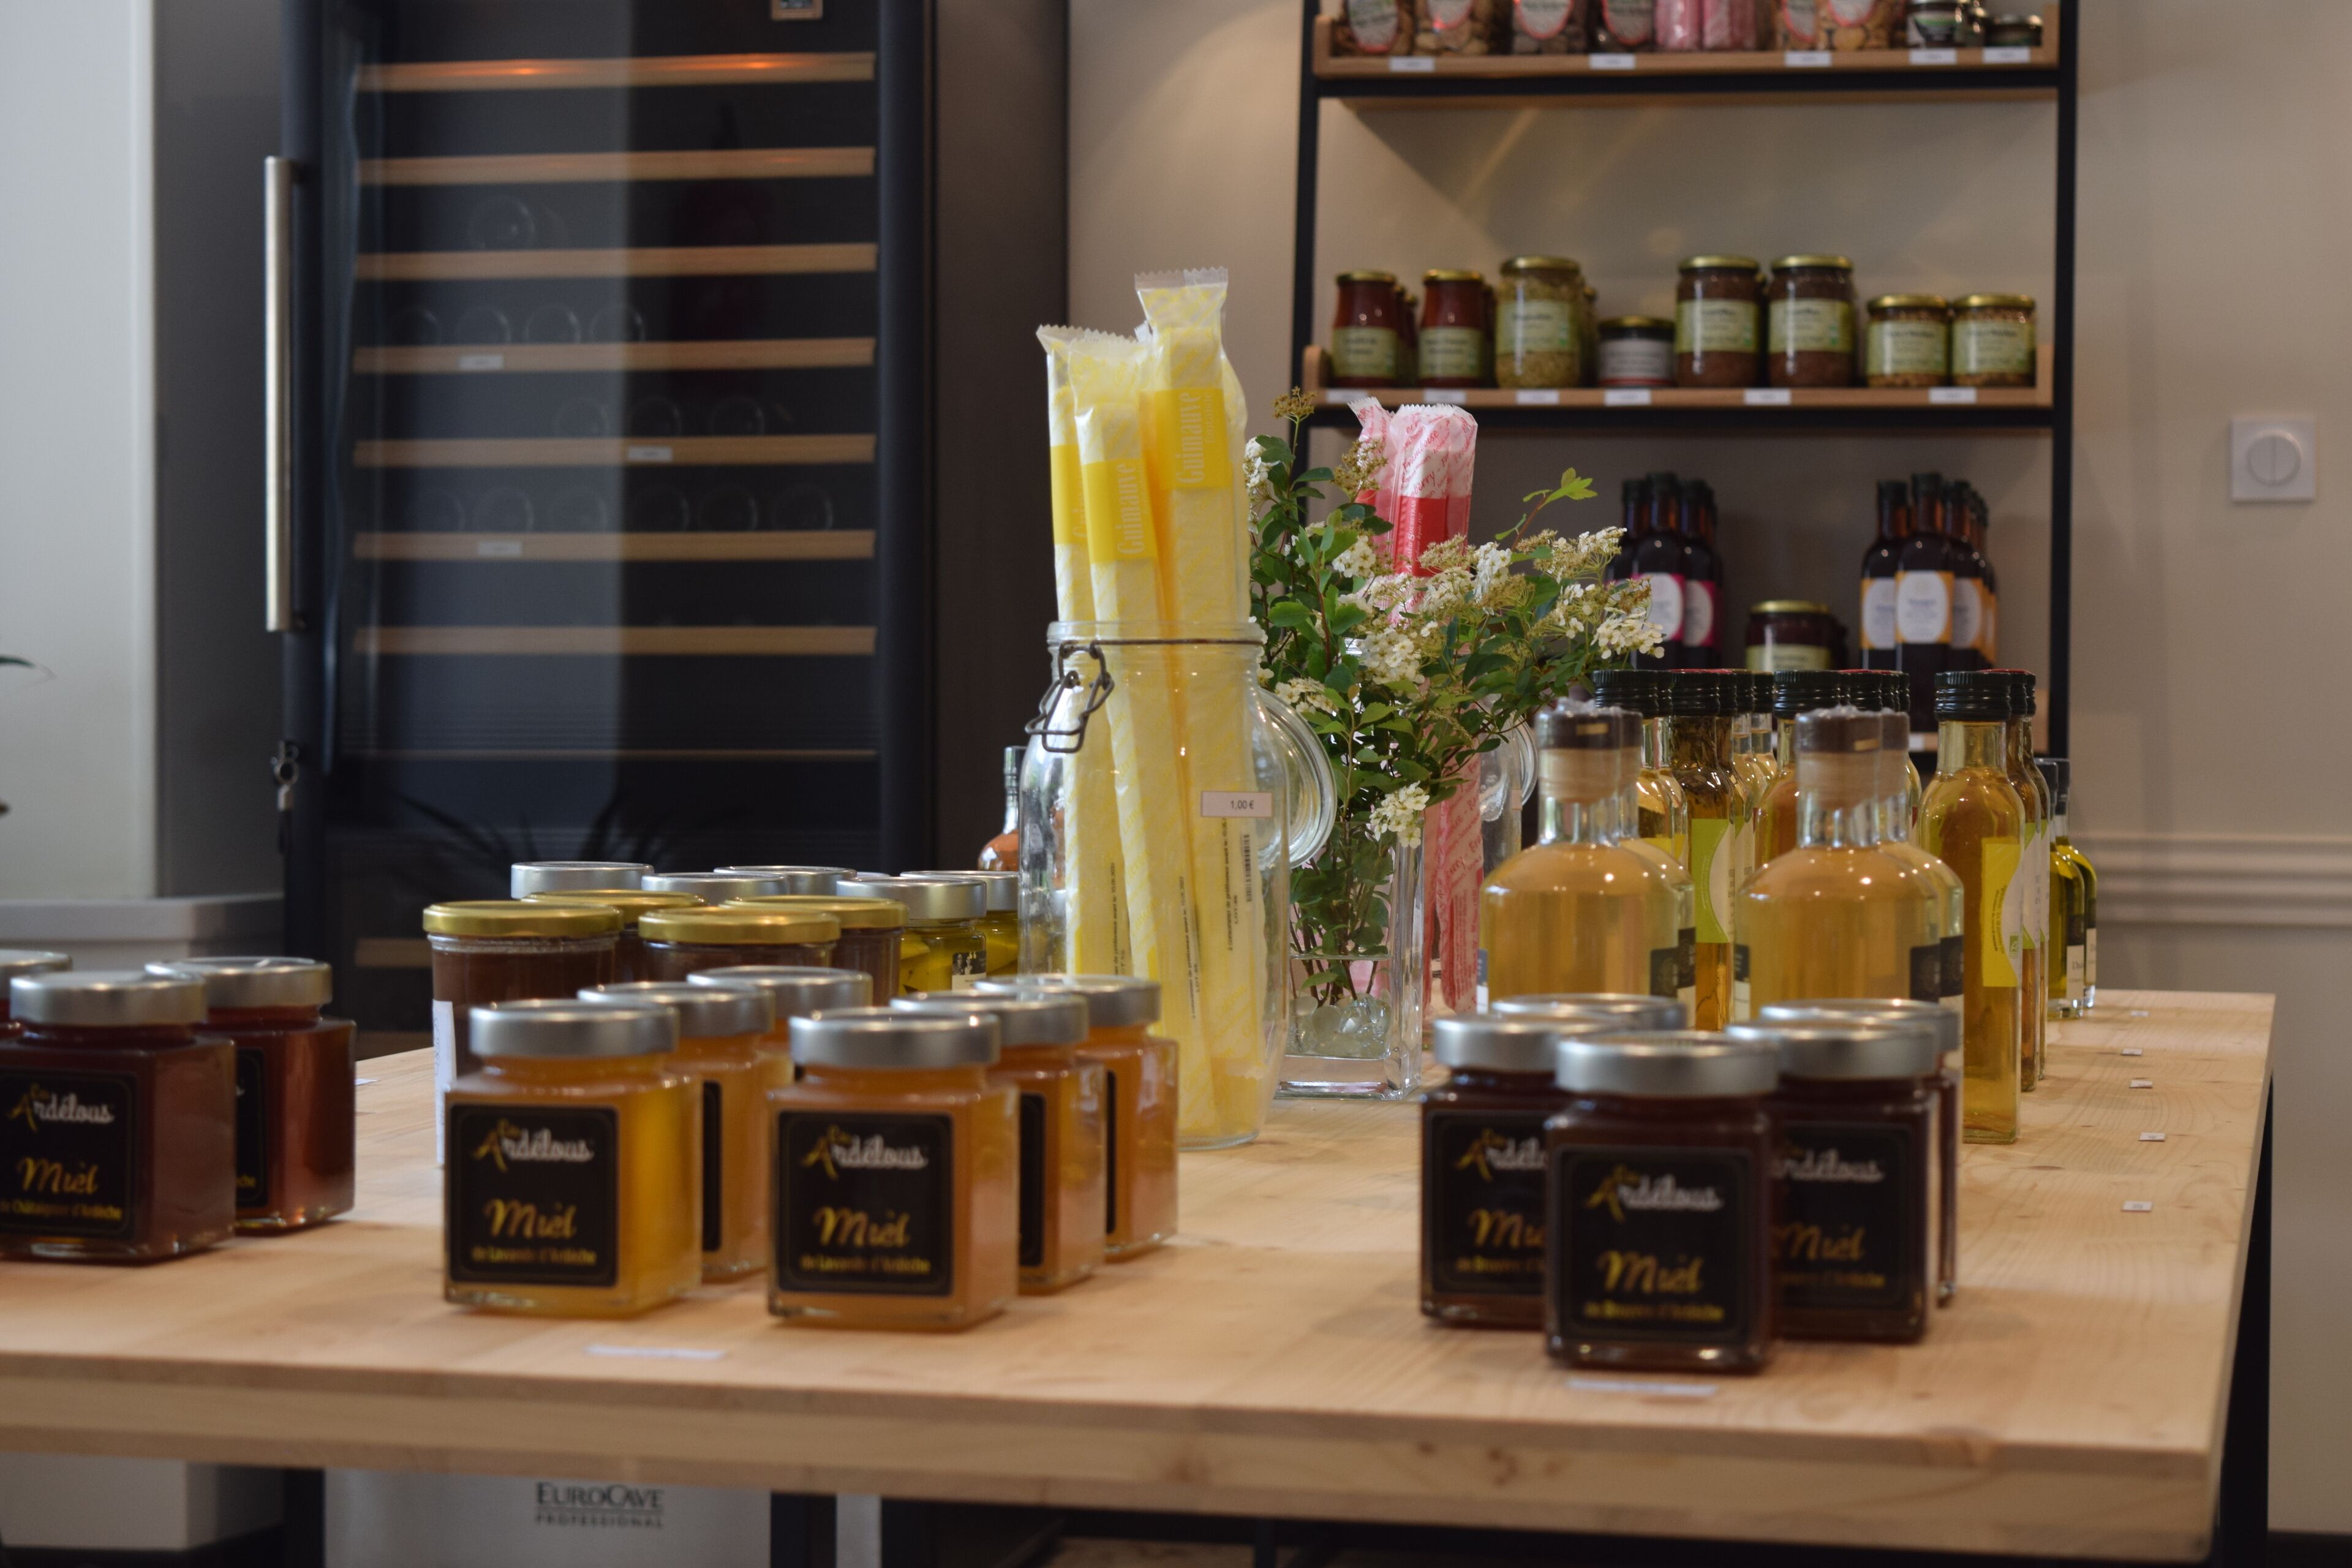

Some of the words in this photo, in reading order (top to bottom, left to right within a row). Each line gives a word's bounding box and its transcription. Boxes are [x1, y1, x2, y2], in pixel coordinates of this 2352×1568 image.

[1175, 392, 1205, 484] Guimauve
[1115, 463, 1146, 554] Guimauve
[1249, 800, 1254, 809] €
